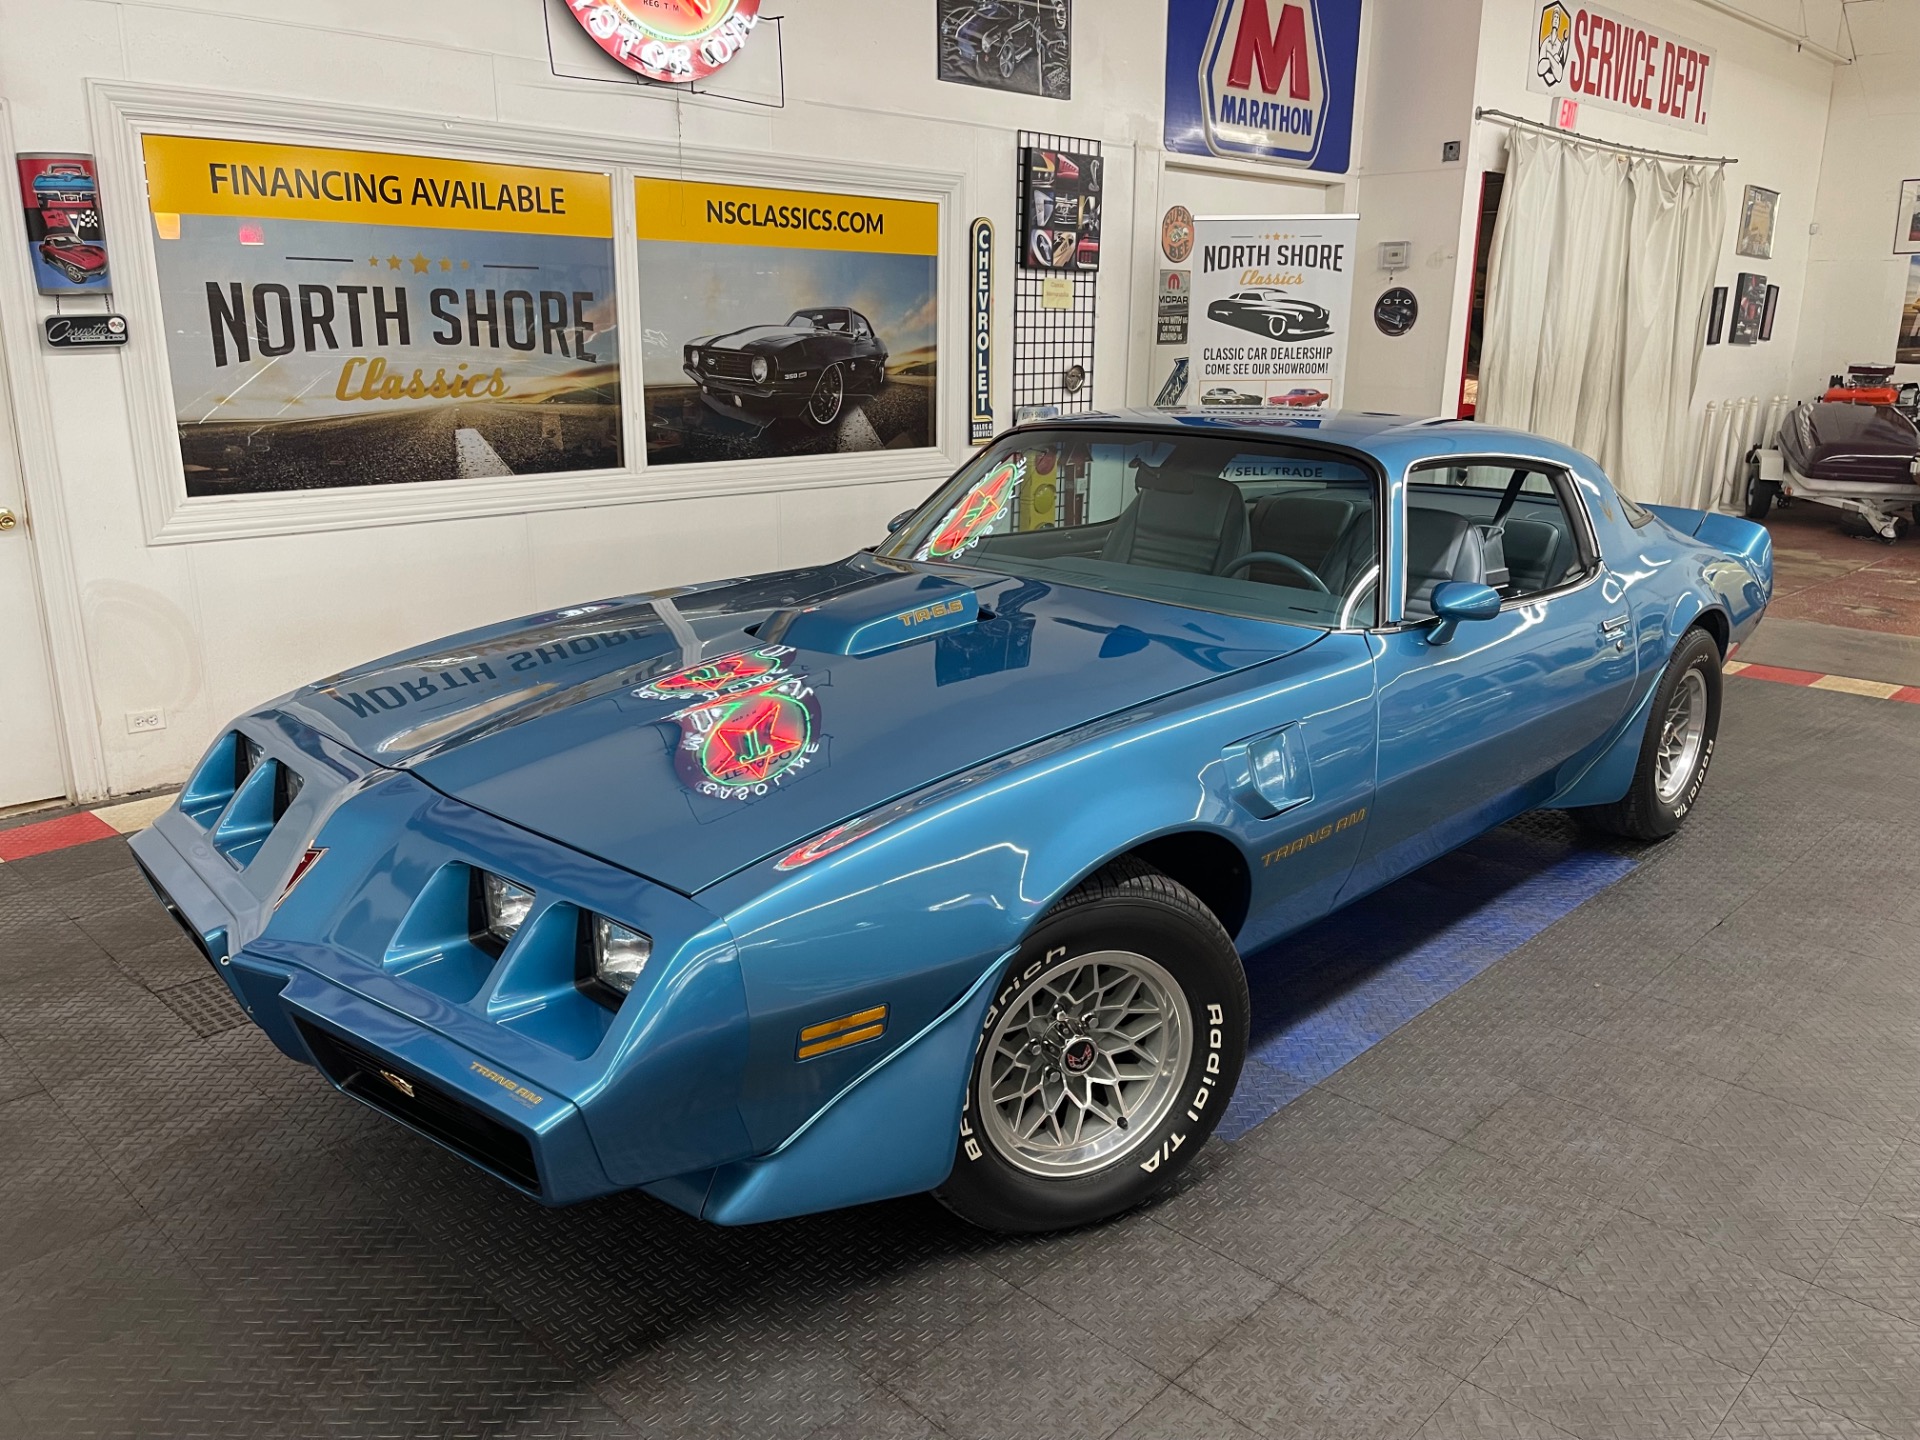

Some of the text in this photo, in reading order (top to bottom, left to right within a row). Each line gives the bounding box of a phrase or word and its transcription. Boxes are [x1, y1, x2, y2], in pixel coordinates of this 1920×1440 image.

[573, 0, 692, 74] OTOR
[1570, 9, 1710, 125] SERVICE DEPT.
[1220, 94, 1313, 136] MARATHON
[209, 163, 566, 215] FINANCING AVAILABLE
[706, 200, 884, 235] NSCLASSICS.COM
[1168, 239, 1190, 259] BEE
[1203, 244, 1344, 274] NORTH SHORE
[1239, 269, 1305, 286] Classics
[977, 229, 991, 412] CHEVROLET
[1158, 295, 1189, 304] MOPAR
[48, 320, 111, 342] Corvette
[205, 281, 598, 368] NORTH SHORE
[1203, 346, 1333, 361] CLASSIC CAR DEALERSHIP
[1205, 362, 1329, 375] COME SEE OUR SHOWROOM!
[335, 356, 512, 402] Classics
[973, 423, 988, 431] SALES
[973, 430, 993, 438] SERVICE
[1688, 740, 1714, 804] Radial
[1261, 807, 1367, 868] TRANS AM
[470, 1061, 519, 1091] TRANS
[515, 1087, 544, 1105] AM
[1140, 1004, 1224, 1173] Radial T/A
